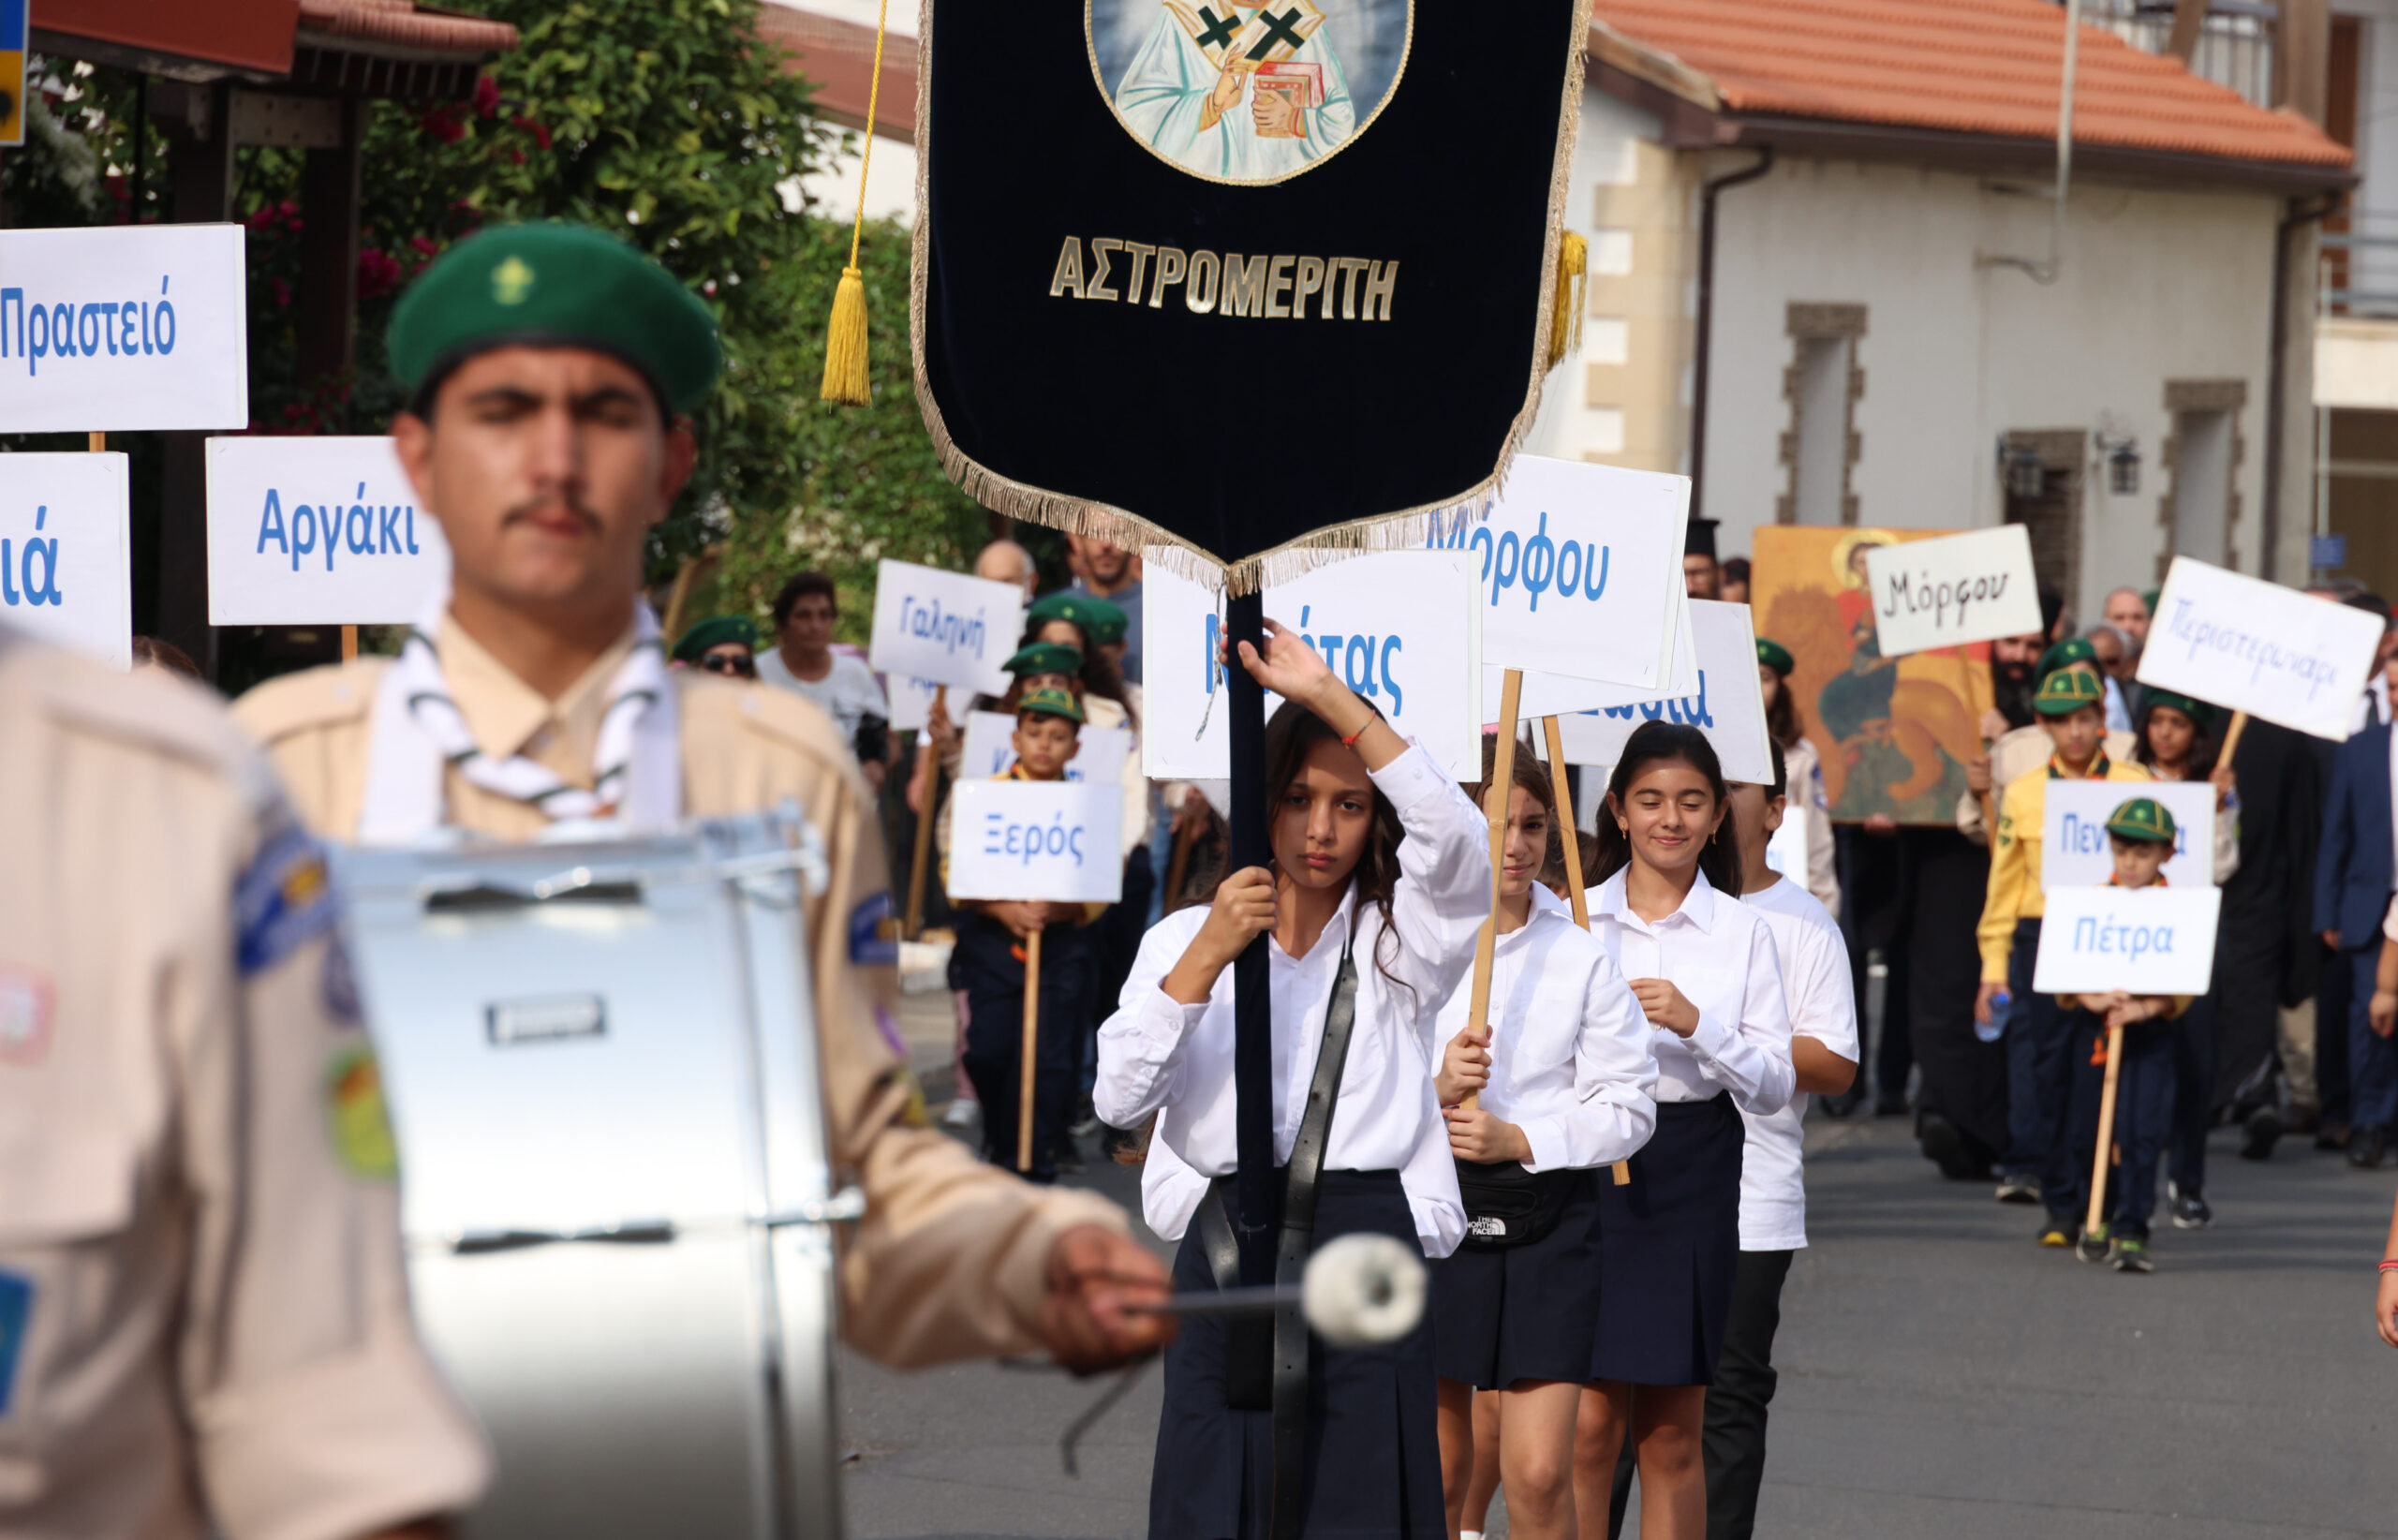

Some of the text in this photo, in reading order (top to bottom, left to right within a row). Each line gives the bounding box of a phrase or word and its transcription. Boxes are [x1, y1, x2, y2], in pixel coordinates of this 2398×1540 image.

[1049, 236, 1399, 320] ΑΣΤΡΟΜΕΡΙΤΗ
[1, 274, 176, 376] Πραστειό
[257, 481, 420, 571] Αργάκι
[984, 811, 1085, 866] Ξερός
[2074, 912, 2175, 962] Πέτρα
